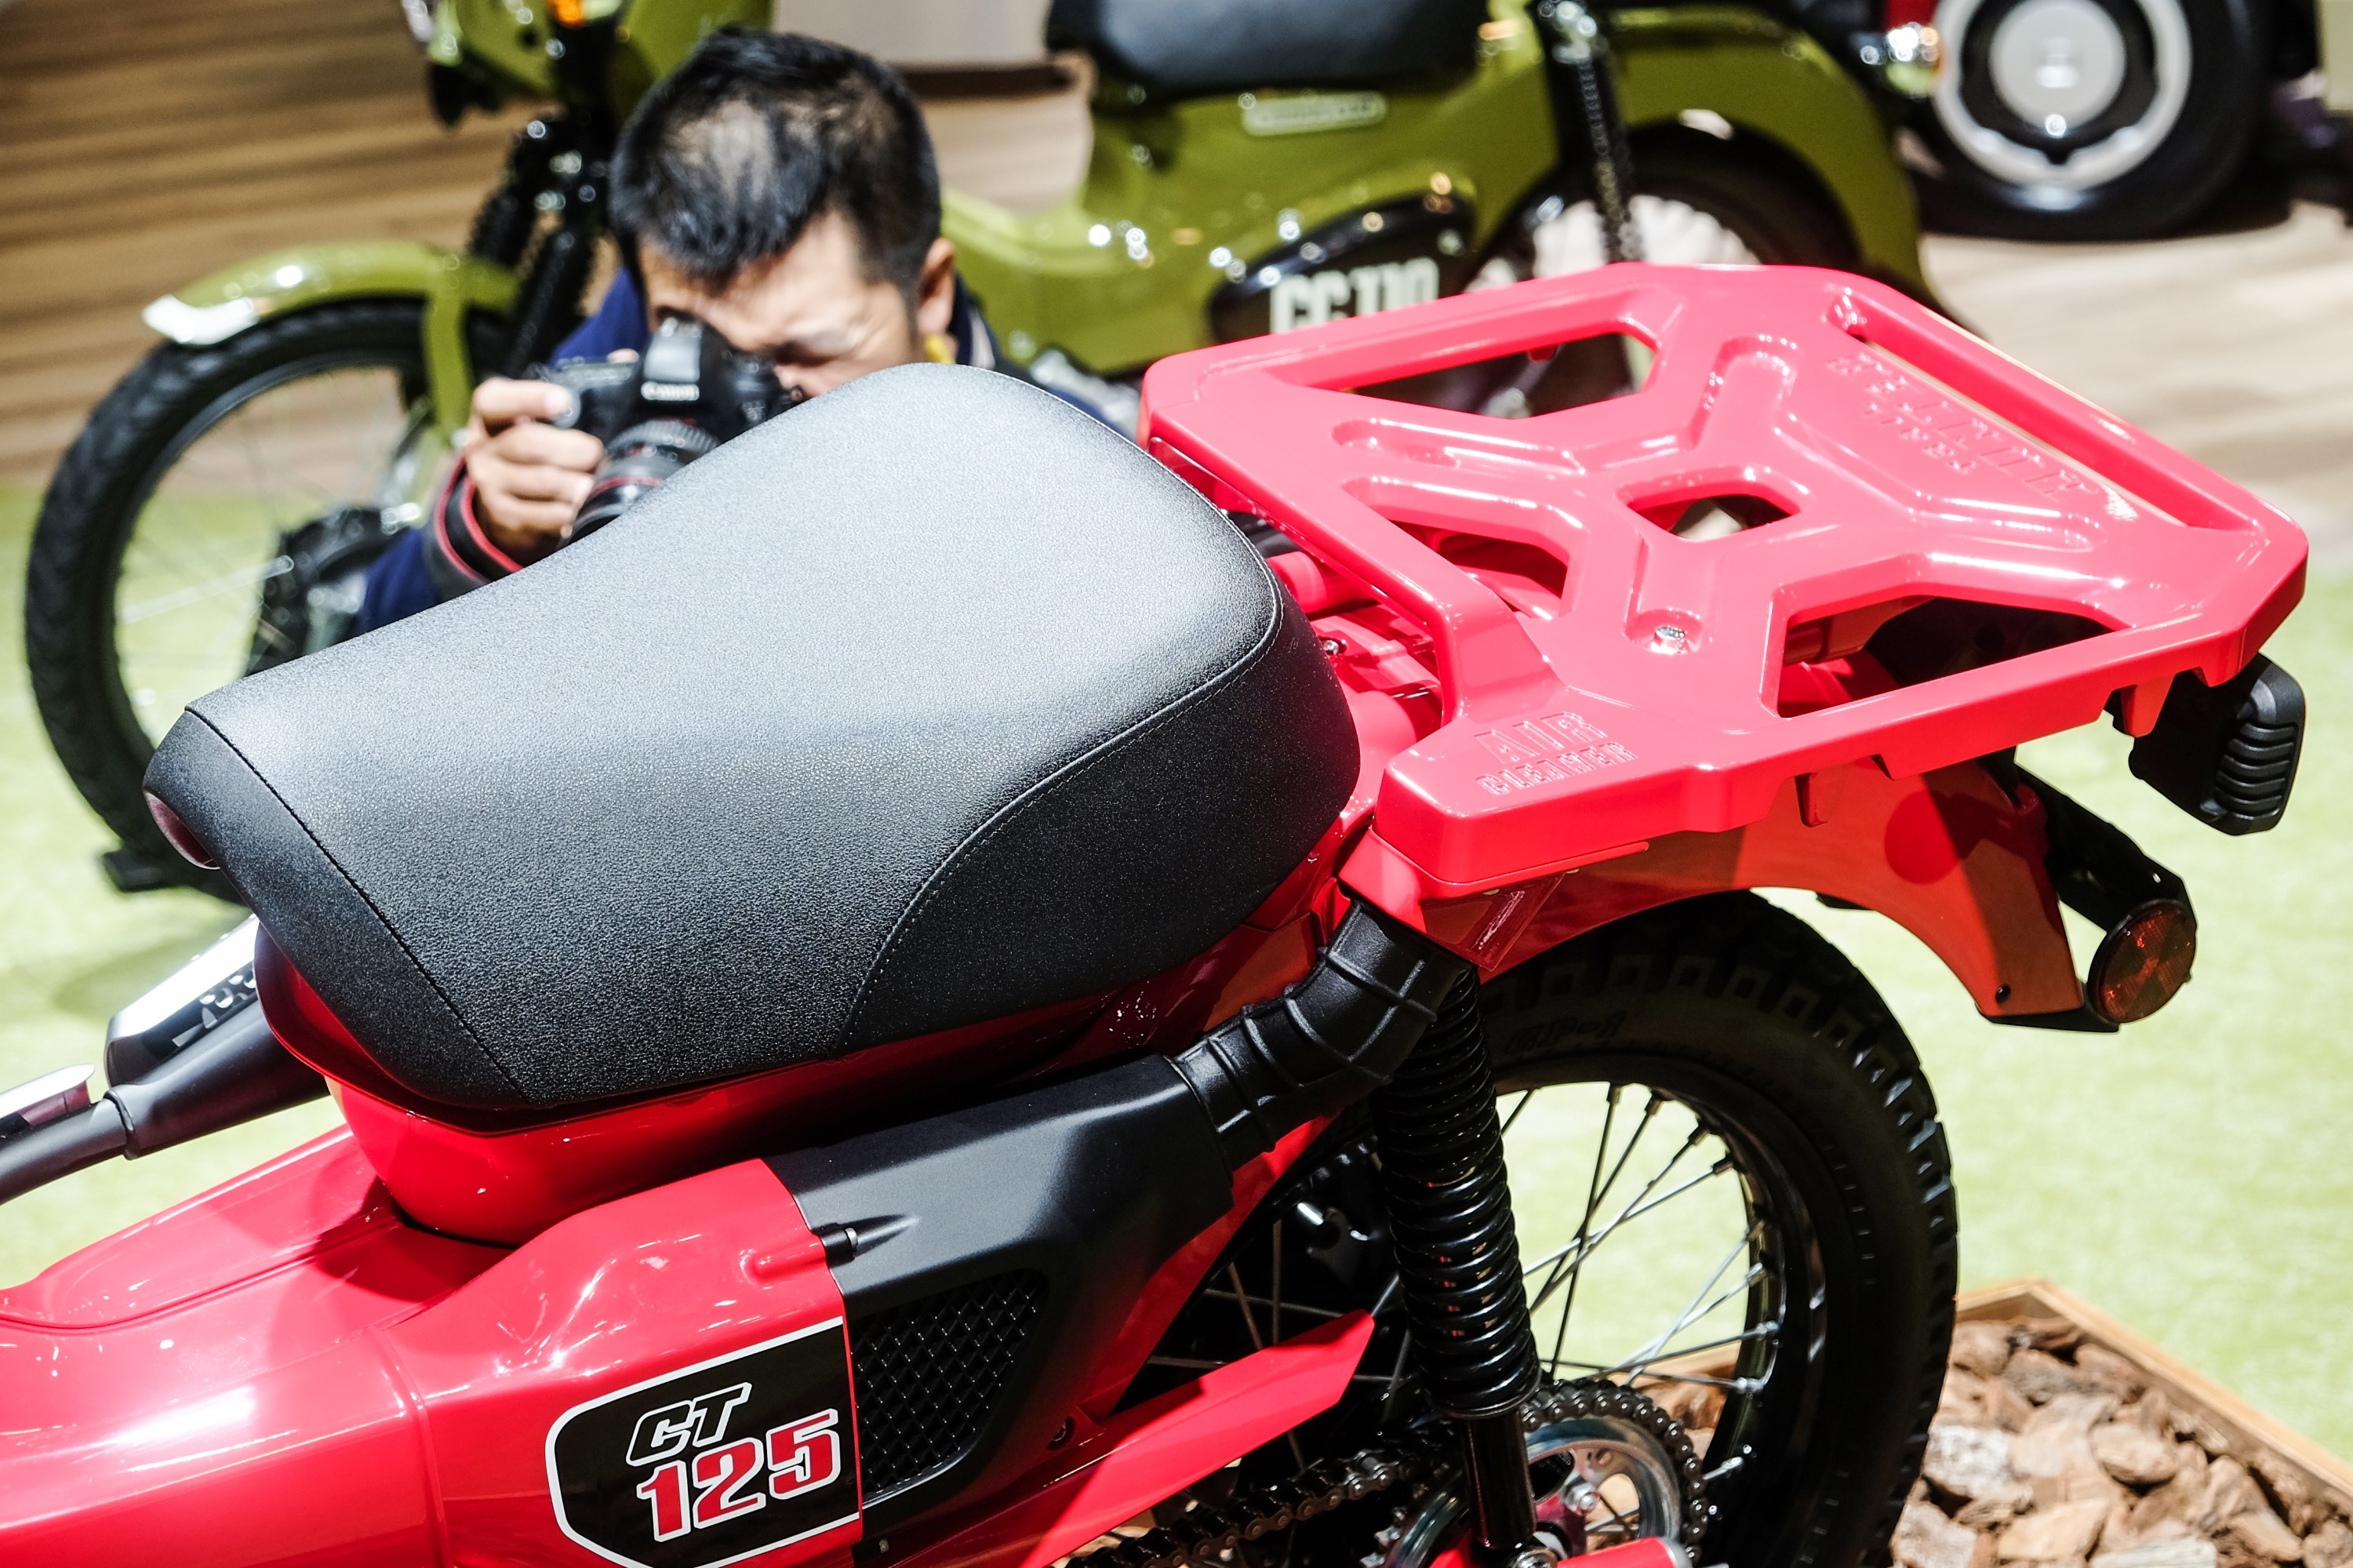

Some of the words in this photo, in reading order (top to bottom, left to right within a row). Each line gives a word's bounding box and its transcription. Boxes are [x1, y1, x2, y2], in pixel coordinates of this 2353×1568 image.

[1474, 711, 1607, 764] AIR
[1475, 743, 1638, 795] CLEANER
[626, 1382, 752, 1466] CT
[636, 1409, 841, 1542] 125
